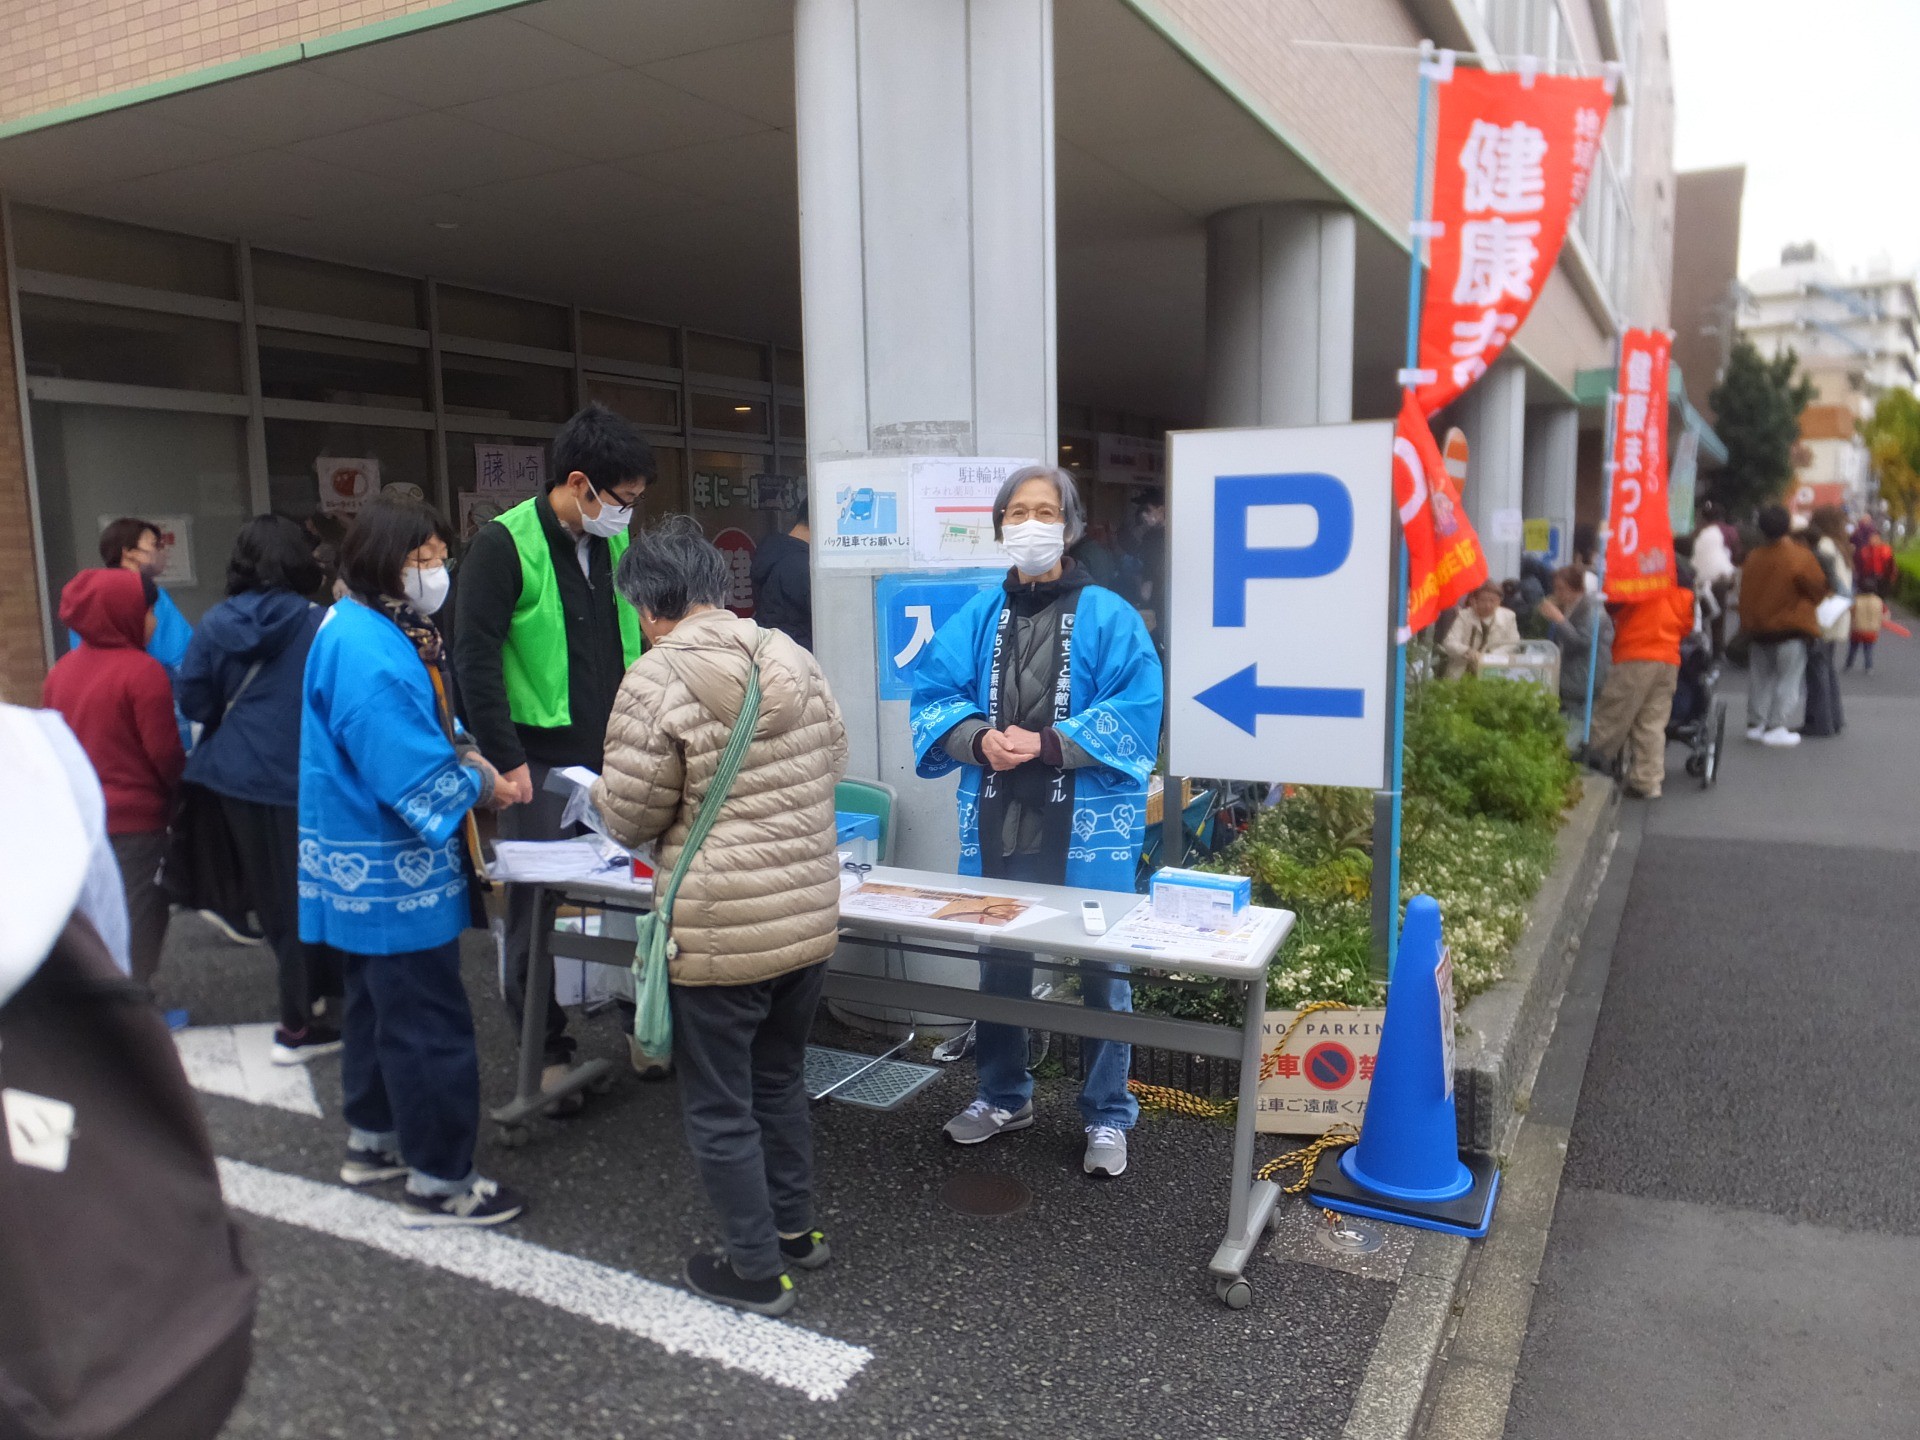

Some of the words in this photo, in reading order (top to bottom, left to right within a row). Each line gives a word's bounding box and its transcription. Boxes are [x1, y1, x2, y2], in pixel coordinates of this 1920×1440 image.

[482, 451, 539, 487] 藤崎
[958, 466, 1007, 484] 駐輪場
[1213, 472, 1355, 628] P
[1262, 1024, 1287, 1035] NO
